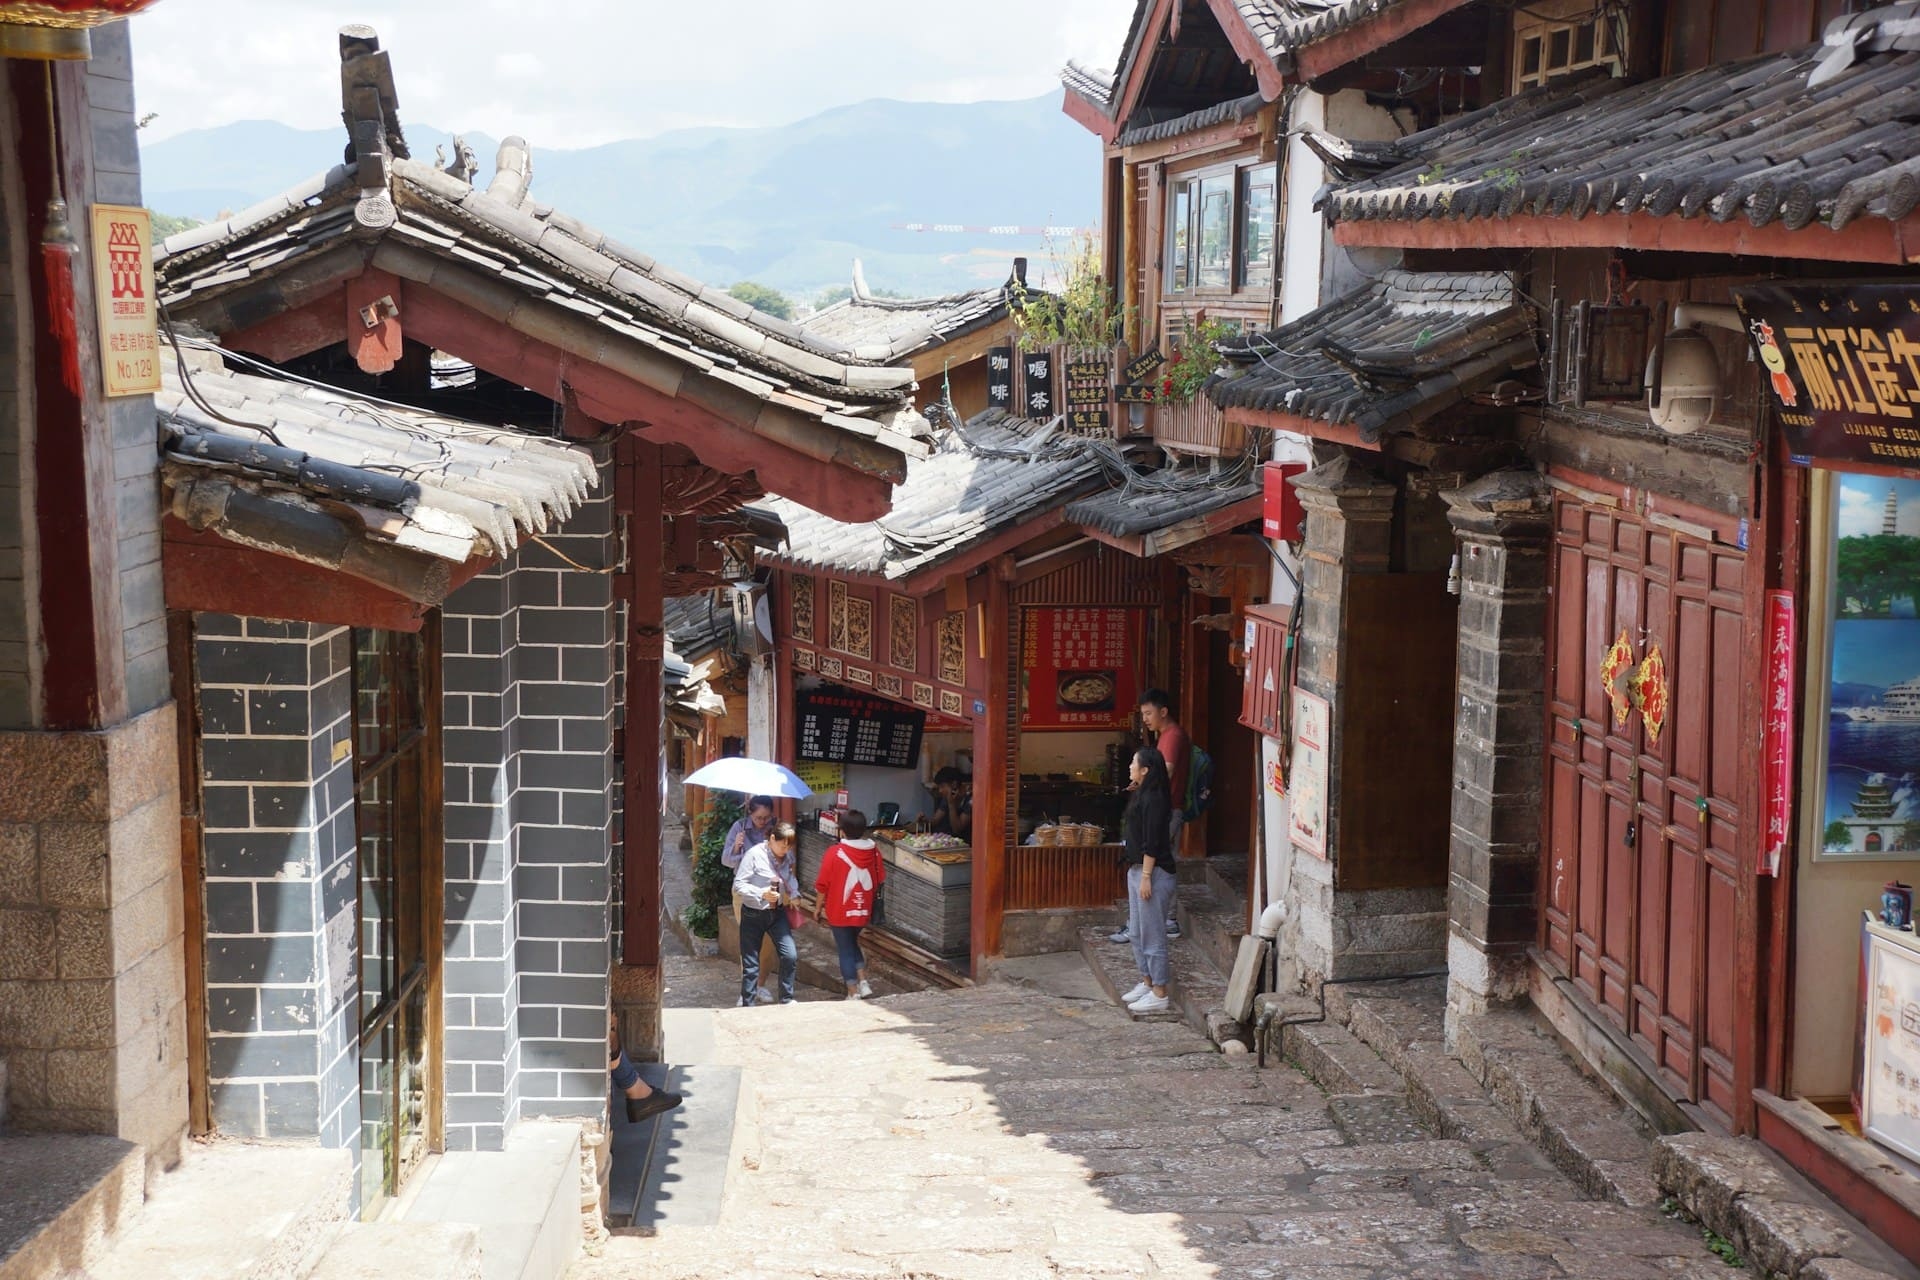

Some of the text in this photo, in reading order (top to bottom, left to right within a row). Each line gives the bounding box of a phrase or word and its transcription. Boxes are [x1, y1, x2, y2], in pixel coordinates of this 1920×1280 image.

[117, 359, 152, 379] No.129
[991, 354, 1009, 401] 咖啡
[1028, 360, 1049, 410] 喝茶
[1843, 422, 1888, 438] LIJIANG
